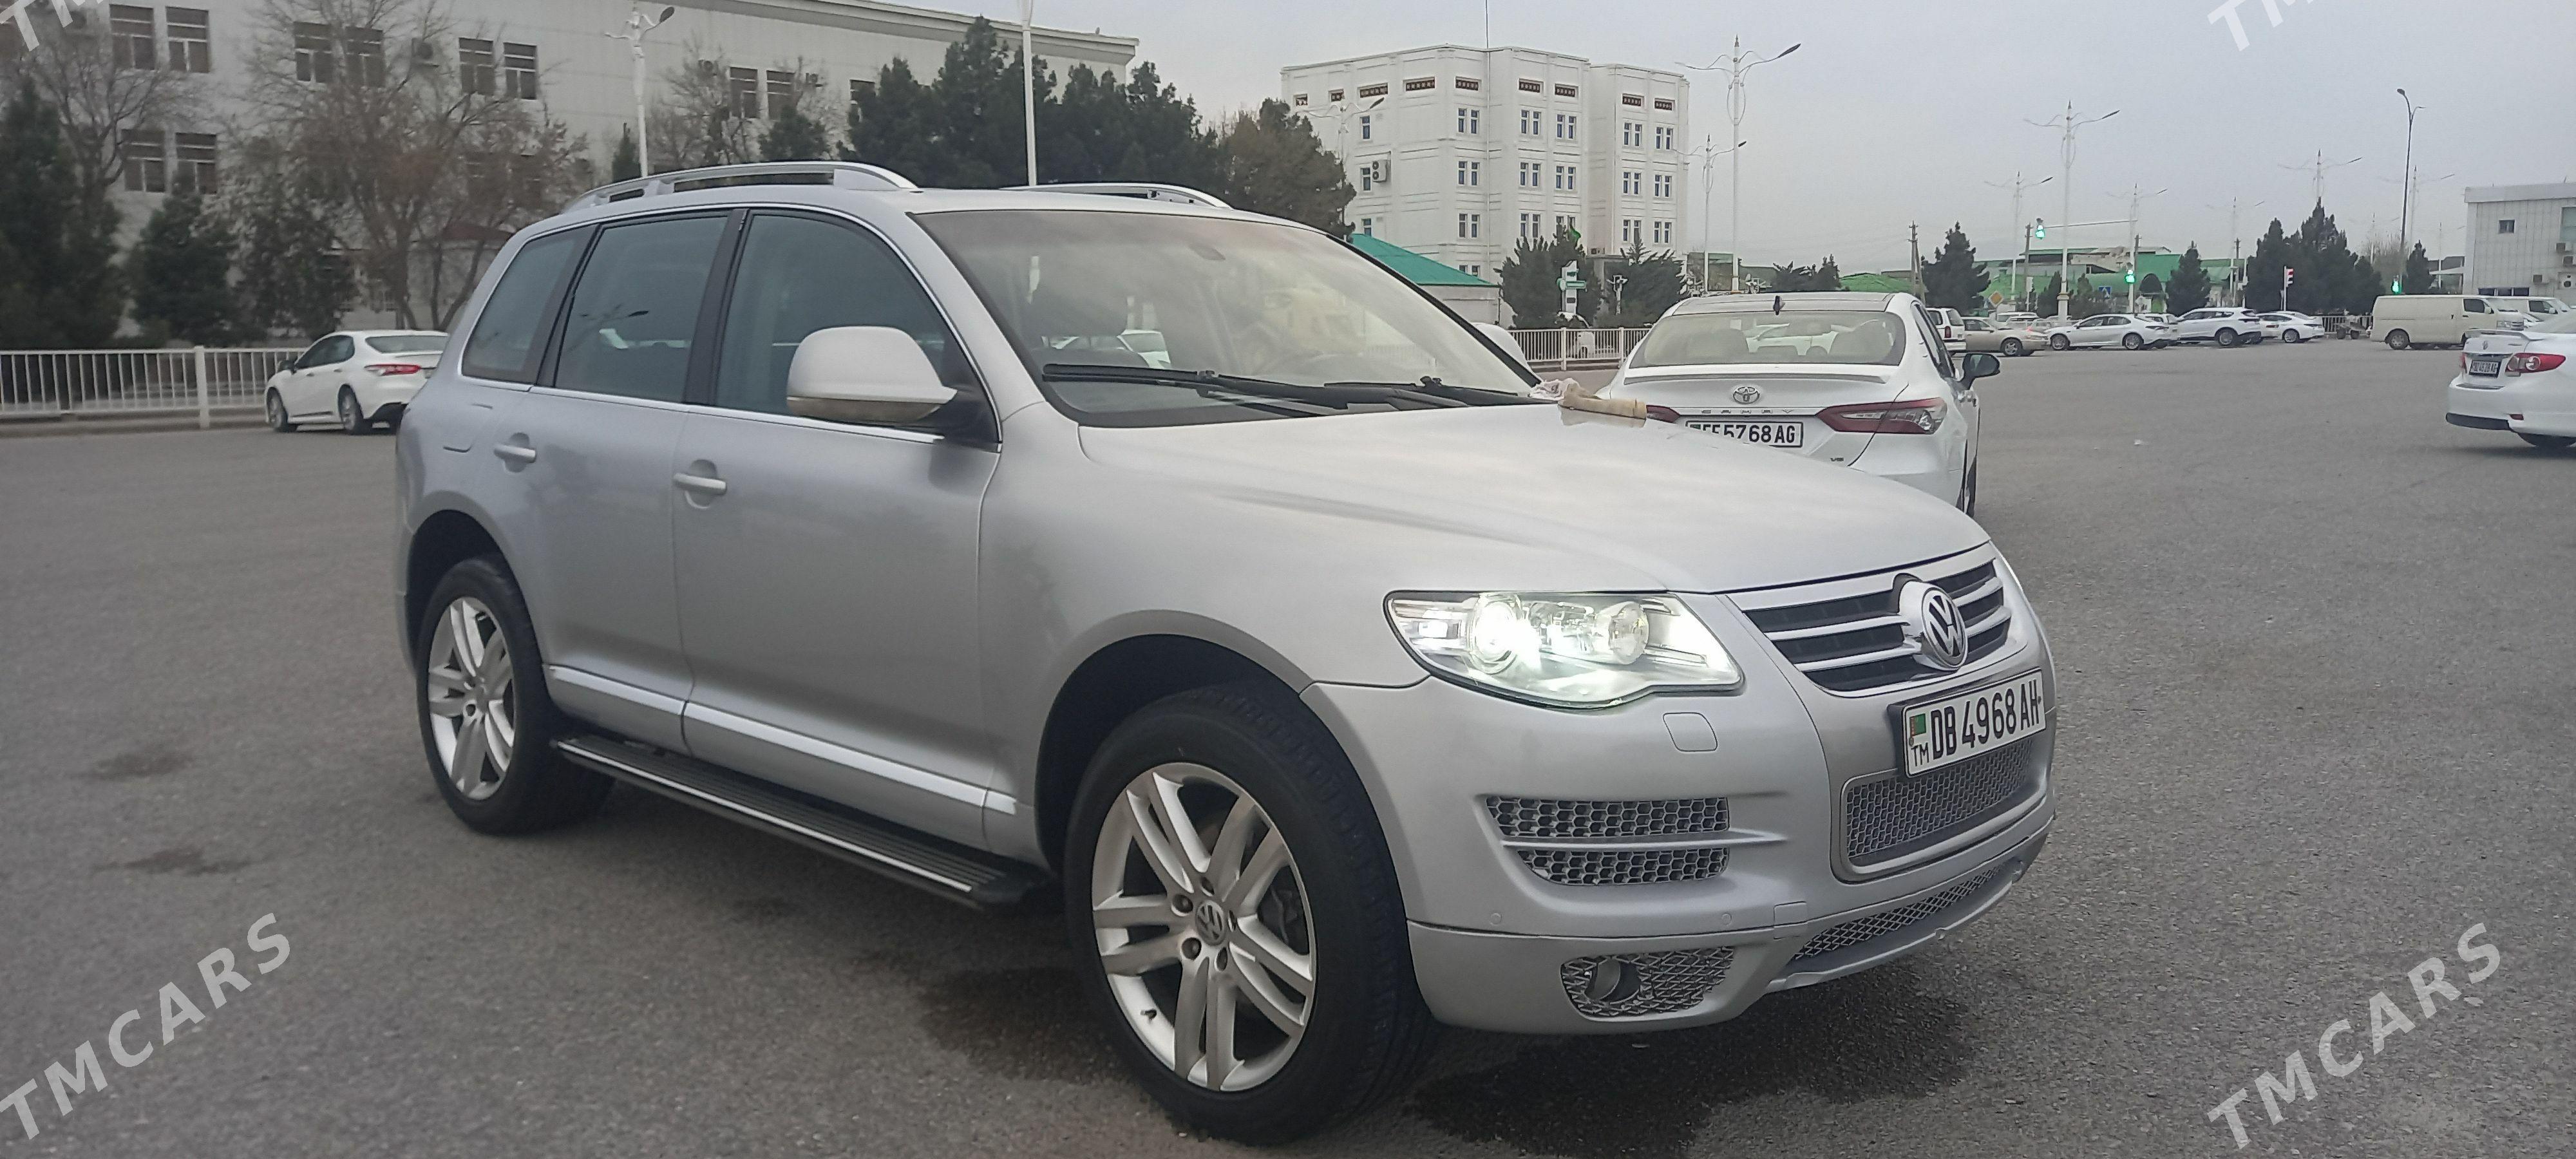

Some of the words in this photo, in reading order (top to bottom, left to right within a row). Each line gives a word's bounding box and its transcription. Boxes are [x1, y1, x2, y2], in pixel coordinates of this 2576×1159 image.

[1774, 425, 1795, 443] AG
[1931, 706, 1956, 760] DB
[1962, 688, 2016, 748] 4968
[1911, 742, 1929, 766] TM
